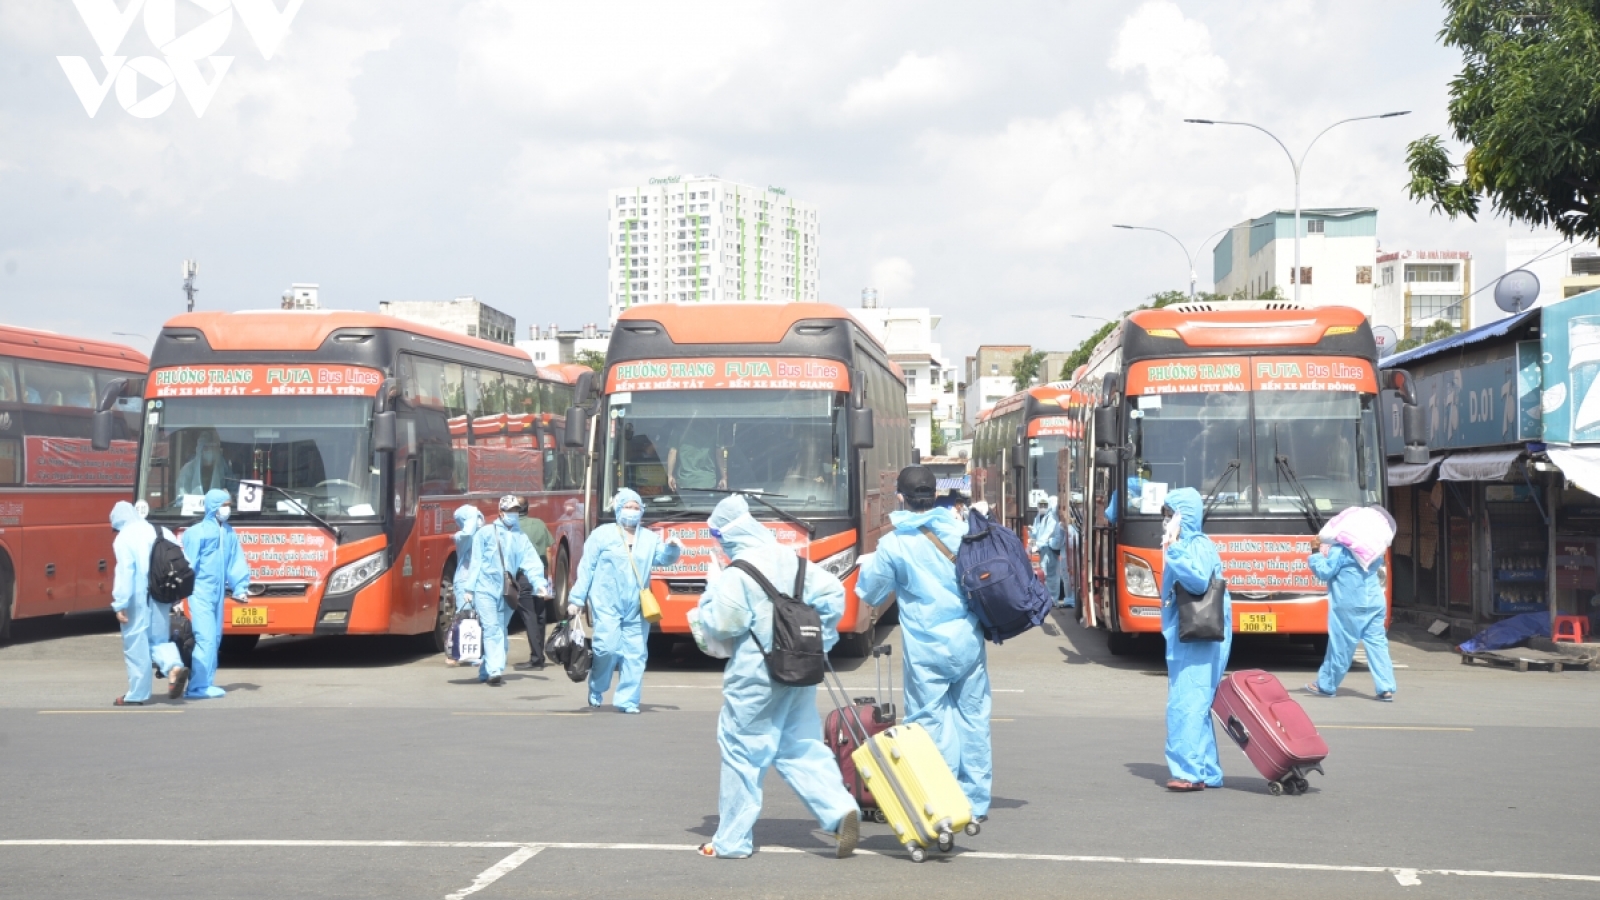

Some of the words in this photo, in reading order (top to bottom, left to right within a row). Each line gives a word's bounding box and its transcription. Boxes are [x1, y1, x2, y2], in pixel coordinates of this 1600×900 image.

[156, 367, 206, 386] PHƯƠNG
[208, 369, 252, 384] TRANG
[266, 368, 313, 384] FUTA
[318, 368, 342, 384] Bus
[345, 367, 379, 384] Lines
[616, 361, 668, 380] PHƯƠNG
[670, 362, 715, 379] TRANG
[725, 361, 772, 377] FUTA
[777, 361, 801, 376] Bus
[805, 362, 838, 378] Lines
[1148, 363, 1197, 382] PHƯƠNG
[1199, 363, 1241, 380] TRANG
[1257, 362, 1302, 378] FUTA
[1306, 362, 1330, 378] Bus
[1332, 362, 1364, 379] Lines
[1469, 387, 1494, 423] D.01
[244, 485, 256, 503] 3
[462, 643, 478, 655] FFF
